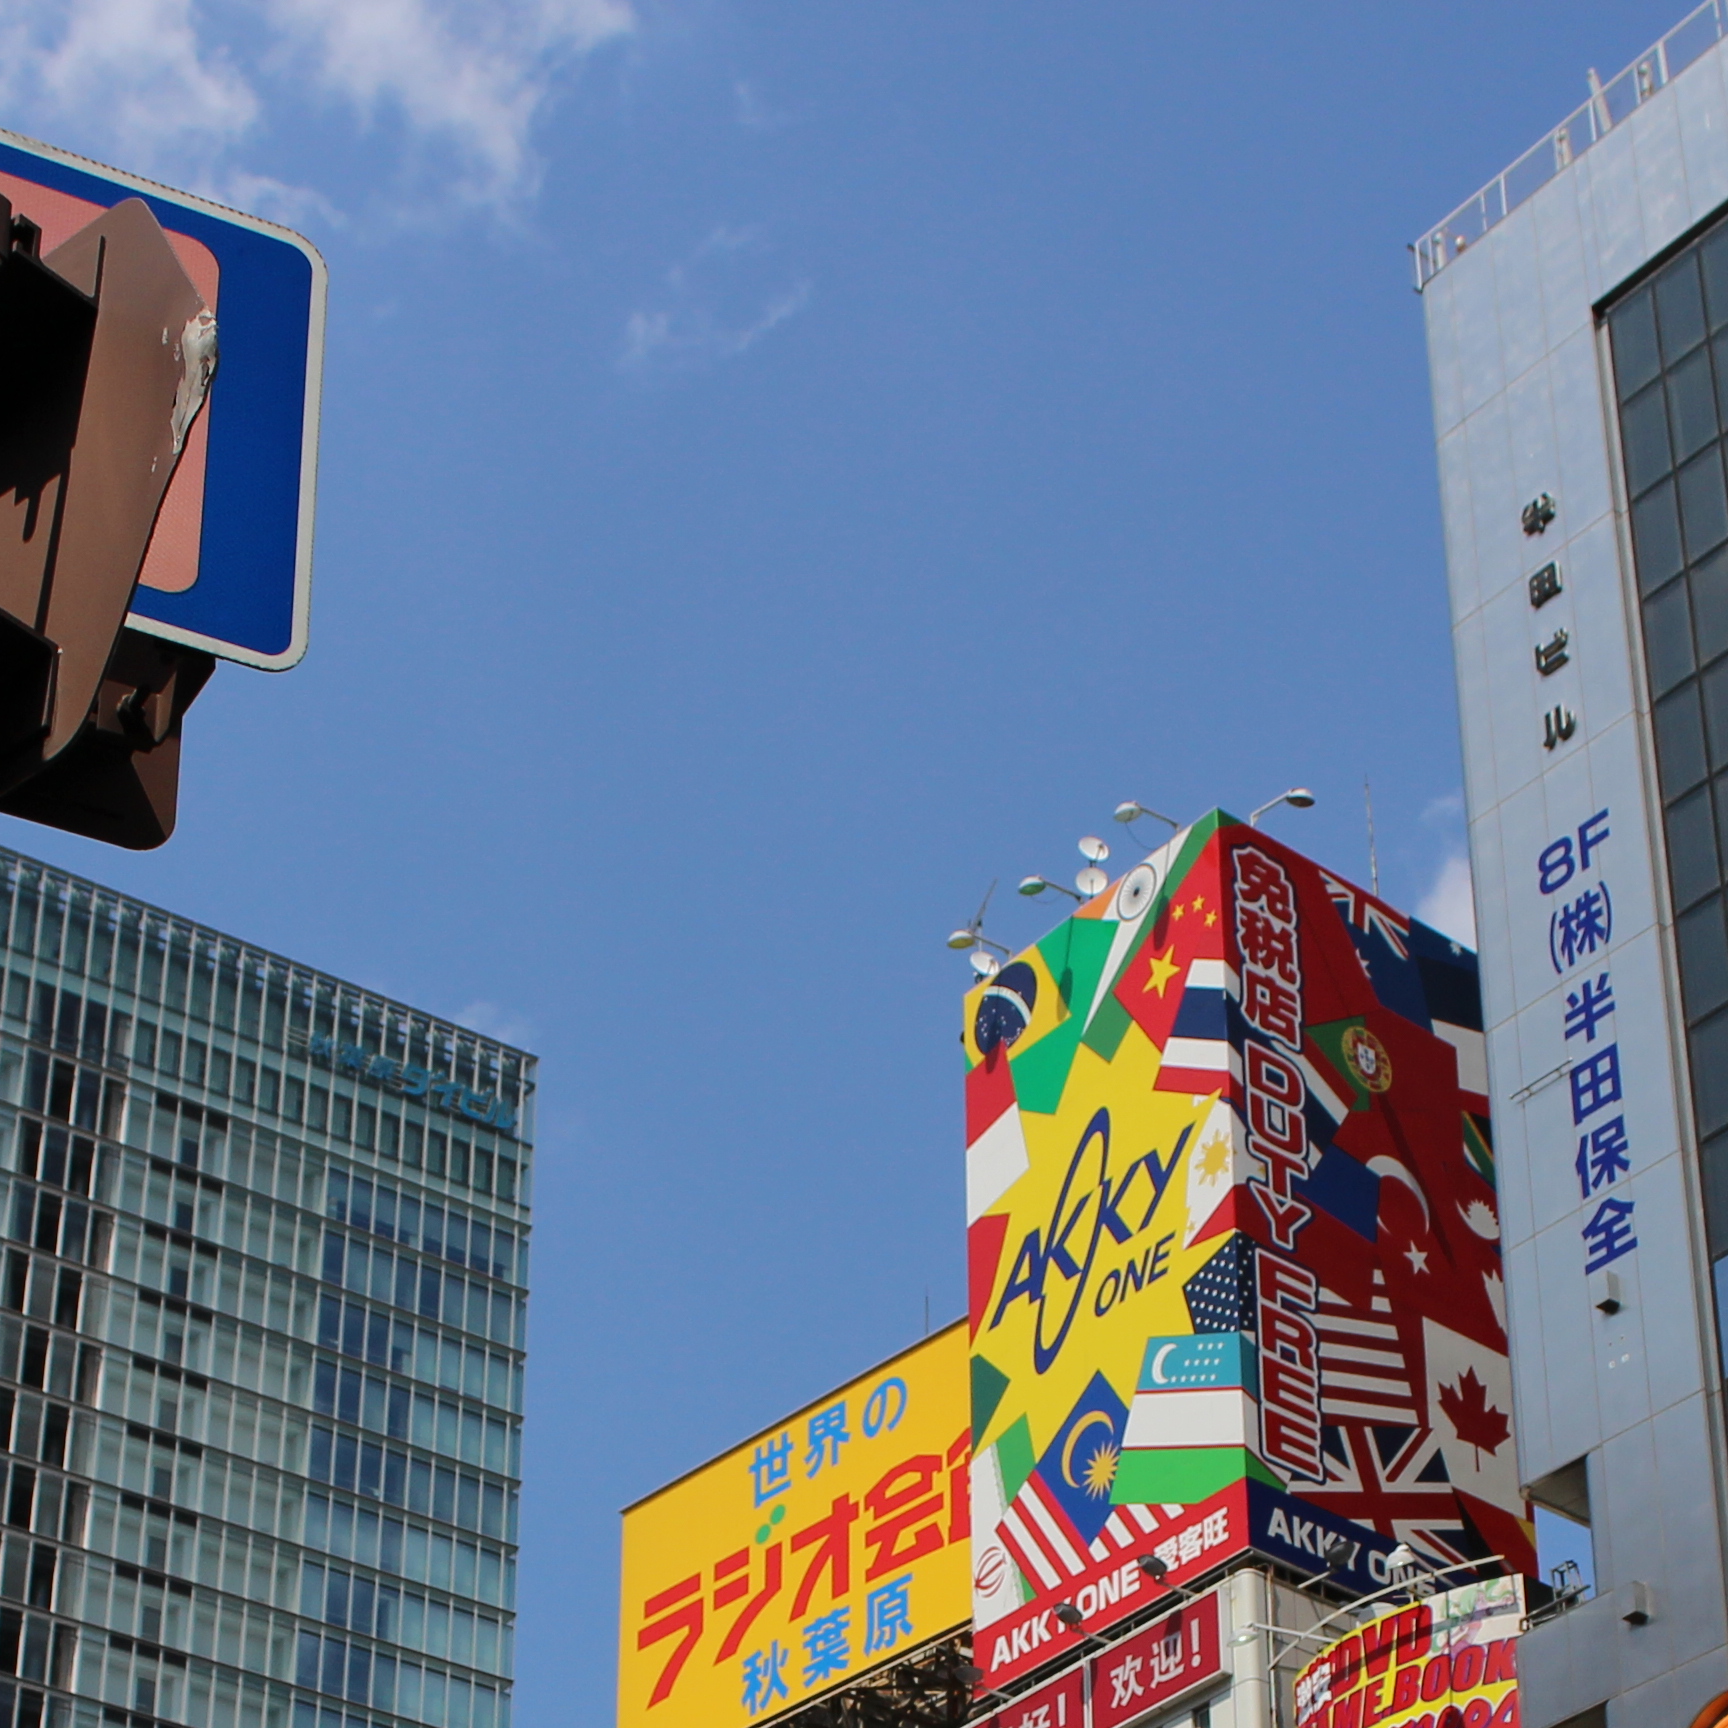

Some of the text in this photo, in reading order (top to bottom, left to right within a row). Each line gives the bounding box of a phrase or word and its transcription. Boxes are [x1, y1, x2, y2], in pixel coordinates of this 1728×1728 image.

[1521, 491, 1577, 751] 半田ビル
[1538, 808, 1639, 1277] 8F (株)半田保全
[988, 1124, 1196, 1336] AKKY
[1244, 1038, 1312, 1252] DUTY
[1093, 1230, 1175, 1320] ONE
[748, 1376, 909, 1508] 世界の
[1251, 1250, 1322, 1484] FREE
[741, 1572, 913, 1718] 秋葉原
[1073, 1556, 1143, 1630] ONE
[1330, 1603, 1433, 1696] DVD
